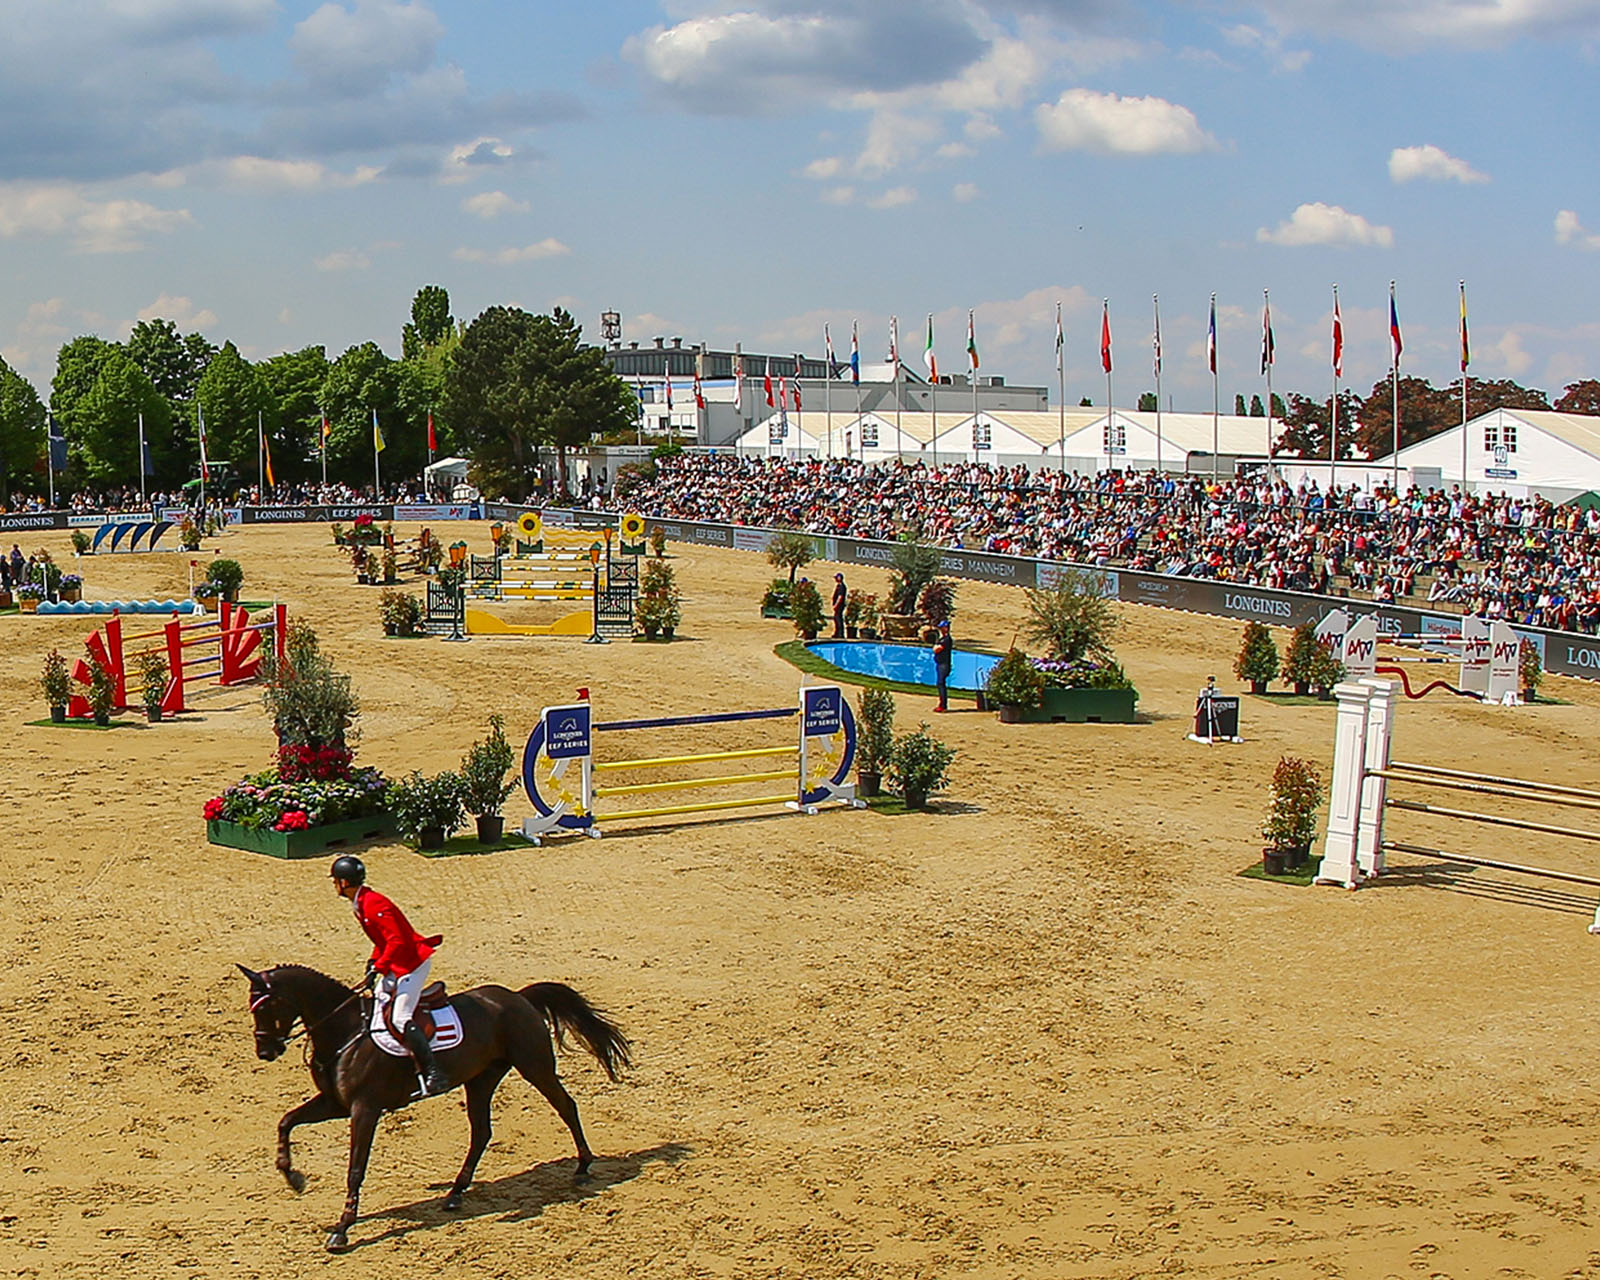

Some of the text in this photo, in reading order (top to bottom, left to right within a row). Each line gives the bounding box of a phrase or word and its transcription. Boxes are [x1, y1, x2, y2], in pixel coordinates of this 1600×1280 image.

[254, 509, 306, 520] LONGINES
[0, 517, 55, 528] LONGINES
[967, 559, 1017, 577] MANNHEIM
[1224, 593, 1293, 618] LONGINES
